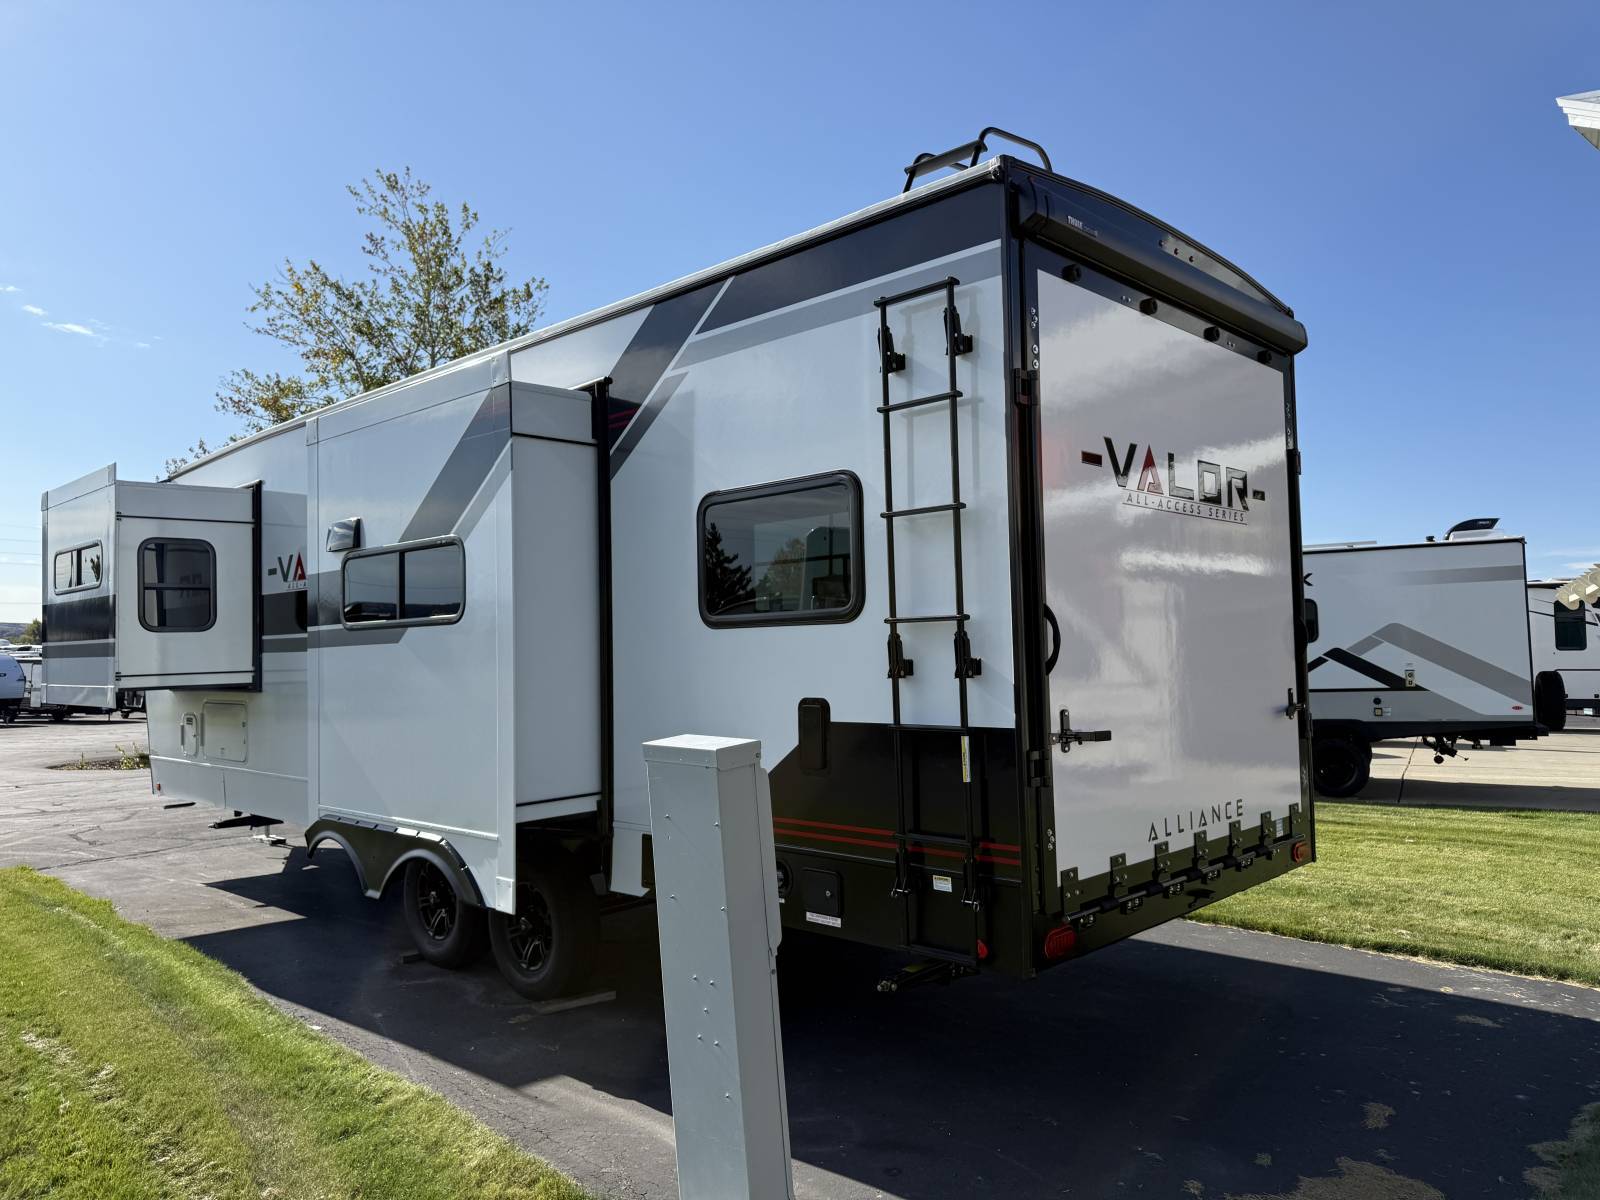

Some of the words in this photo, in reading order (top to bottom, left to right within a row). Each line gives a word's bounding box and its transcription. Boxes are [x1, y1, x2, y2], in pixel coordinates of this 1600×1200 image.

[1126, 492, 1201, 515] ALL-ACCESS
[1208, 507, 1244, 522] SERIES
[1148, 798, 1243, 842] ALLIANCE
